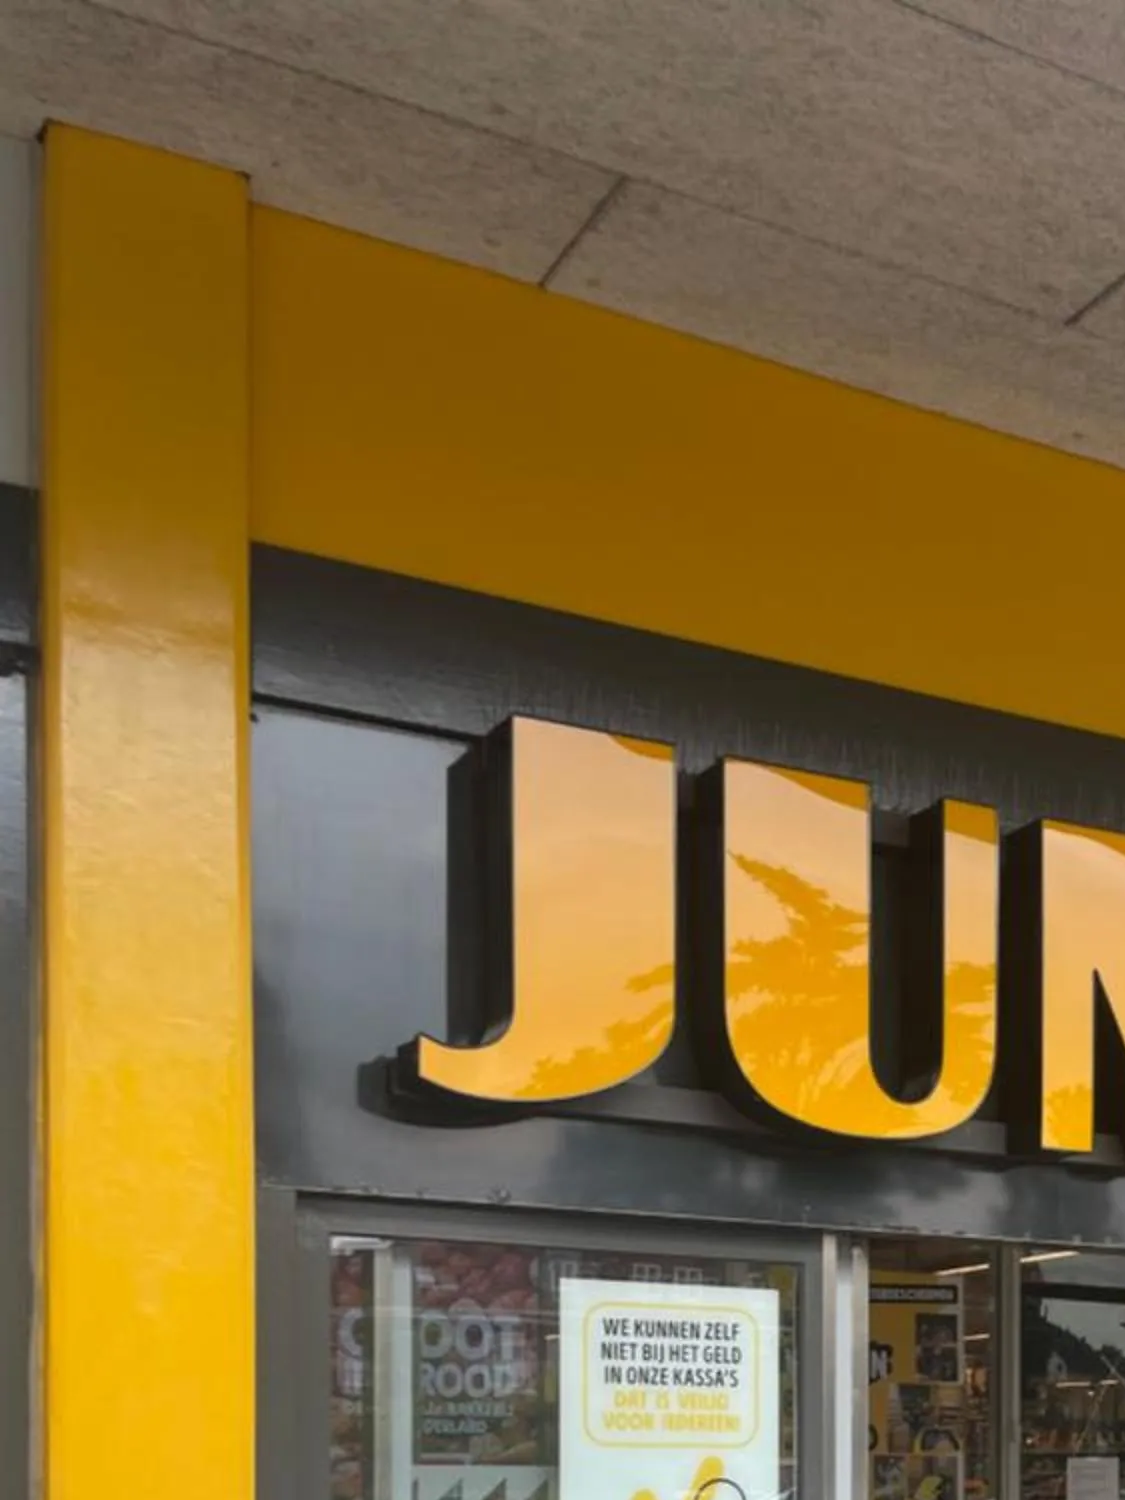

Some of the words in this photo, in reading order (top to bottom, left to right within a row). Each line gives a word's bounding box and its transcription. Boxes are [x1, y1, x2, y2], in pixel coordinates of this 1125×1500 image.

[603, 1317, 630, 1336] WE
[634, 1319, 700, 1340] KUNNEN
[704, 1322, 740, 1341] ZELF
[601, 1342, 638, 1361] NIET
[641, 1343, 665, 1363] BIJ
[669, 1344, 700, 1362] HET
[703, 1346, 742, 1365] GELD
[604, 1366, 622, 1384] IN
[626, 1366, 669, 1385] ONZE
[672, 1368, 739, 1387] KASSA'S
